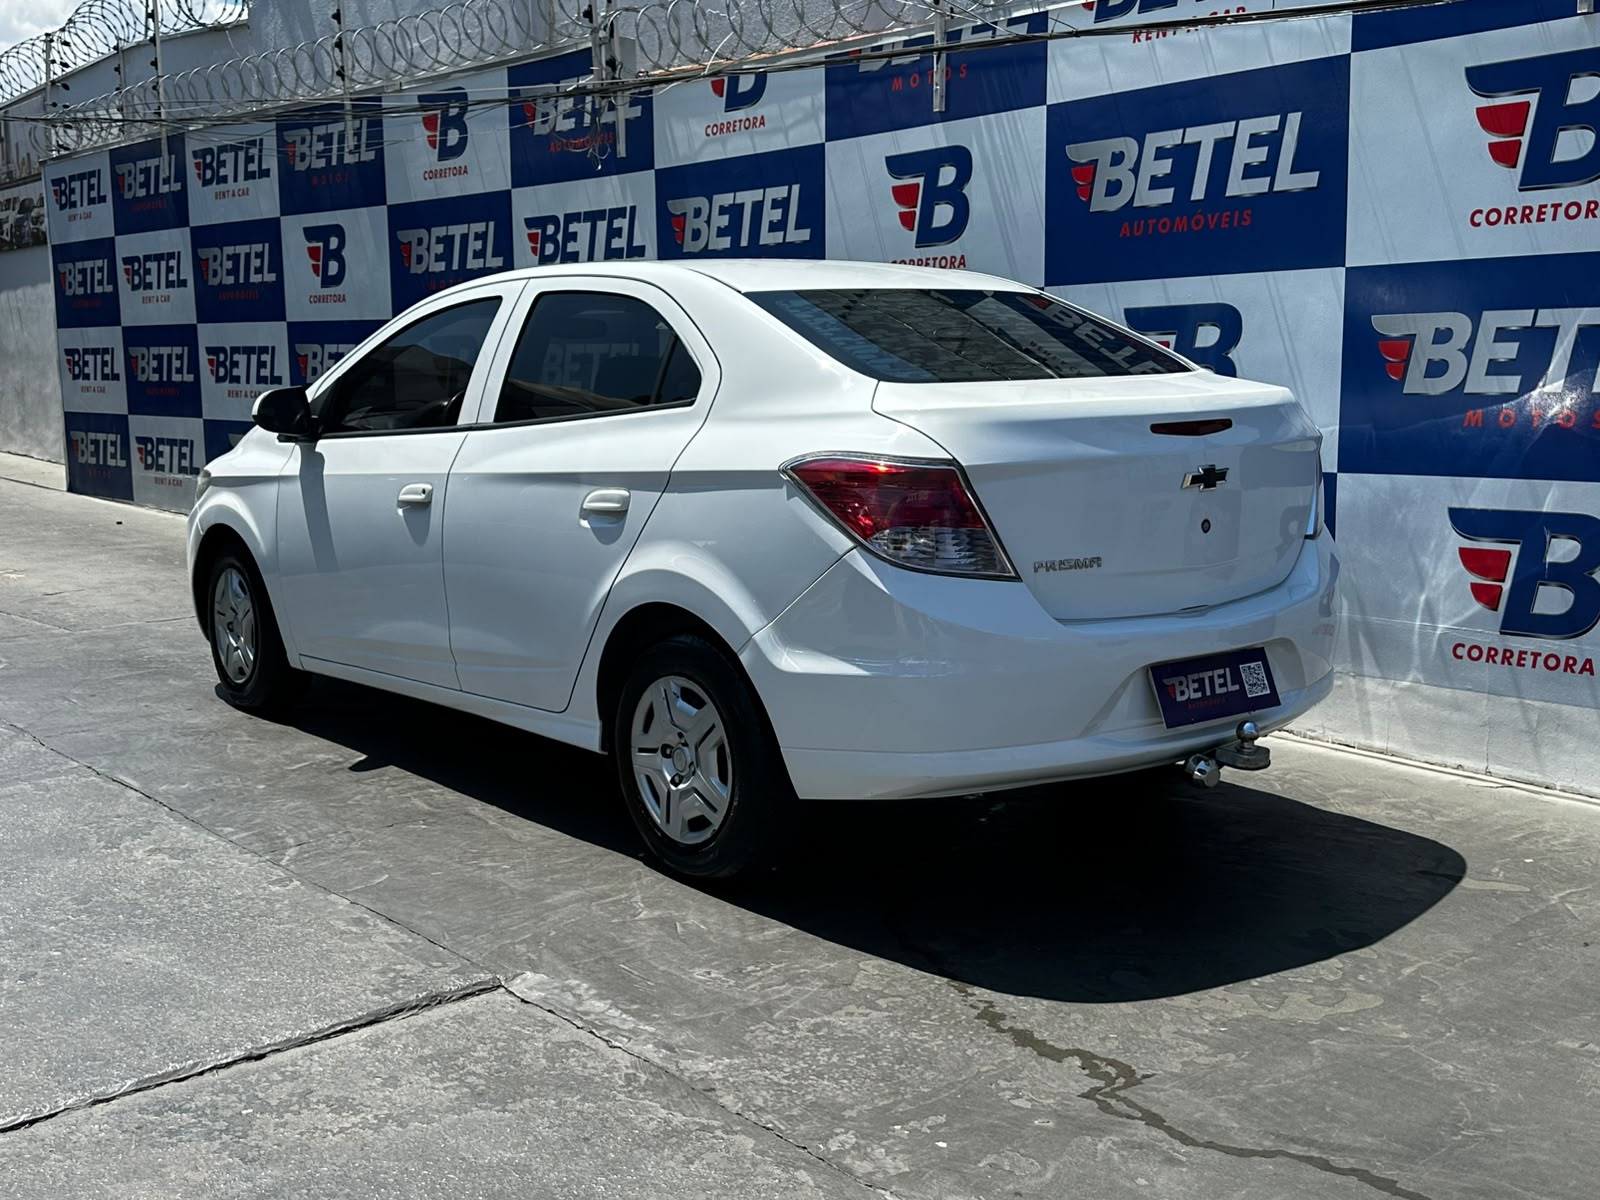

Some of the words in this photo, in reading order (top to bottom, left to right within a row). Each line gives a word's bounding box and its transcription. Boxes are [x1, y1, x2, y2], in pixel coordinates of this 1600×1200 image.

[417, 86, 469, 162] B
[704, 115, 766, 138] CORRETORA
[1464, 45, 1600, 193] B
[191, 138, 271, 188] BETEL
[422, 165, 469, 181] CORRETORA
[1065, 111, 1321, 213] BETEL
[51, 168, 107, 212] BETEL
[884, 145, 973, 249] B
[666, 183, 812, 253] BETEL
[1119, 208, 1253, 238] AUTOMÓVEIS
[1469, 200, 1600, 228] CORRETOR
[396, 220, 504, 274] BETEL
[524, 205, 647, 265] BETEL
[121, 250, 188, 292] BETEL
[197, 242, 277, 286] BETEL
[302, 223, 347, 289] B
[57, 258, 113, 297] BETEL
[308, 293, 347, 305] CORRETORA
[63, 347, 121, 382] BETEL
[127, 346, 194, 383] BETEL
[205, 345, 283, 385] BETEL
[70, 430, 127, 468] BETEL
[135, 435, 200, 476] BETEL
[1033, 556, 1103, 574] PRISMA
[1447, 506, 1600, 641] B
[1451, 642, 1596, 677] CORRETORA
[1162, 667, 1240, 703] BETEL
